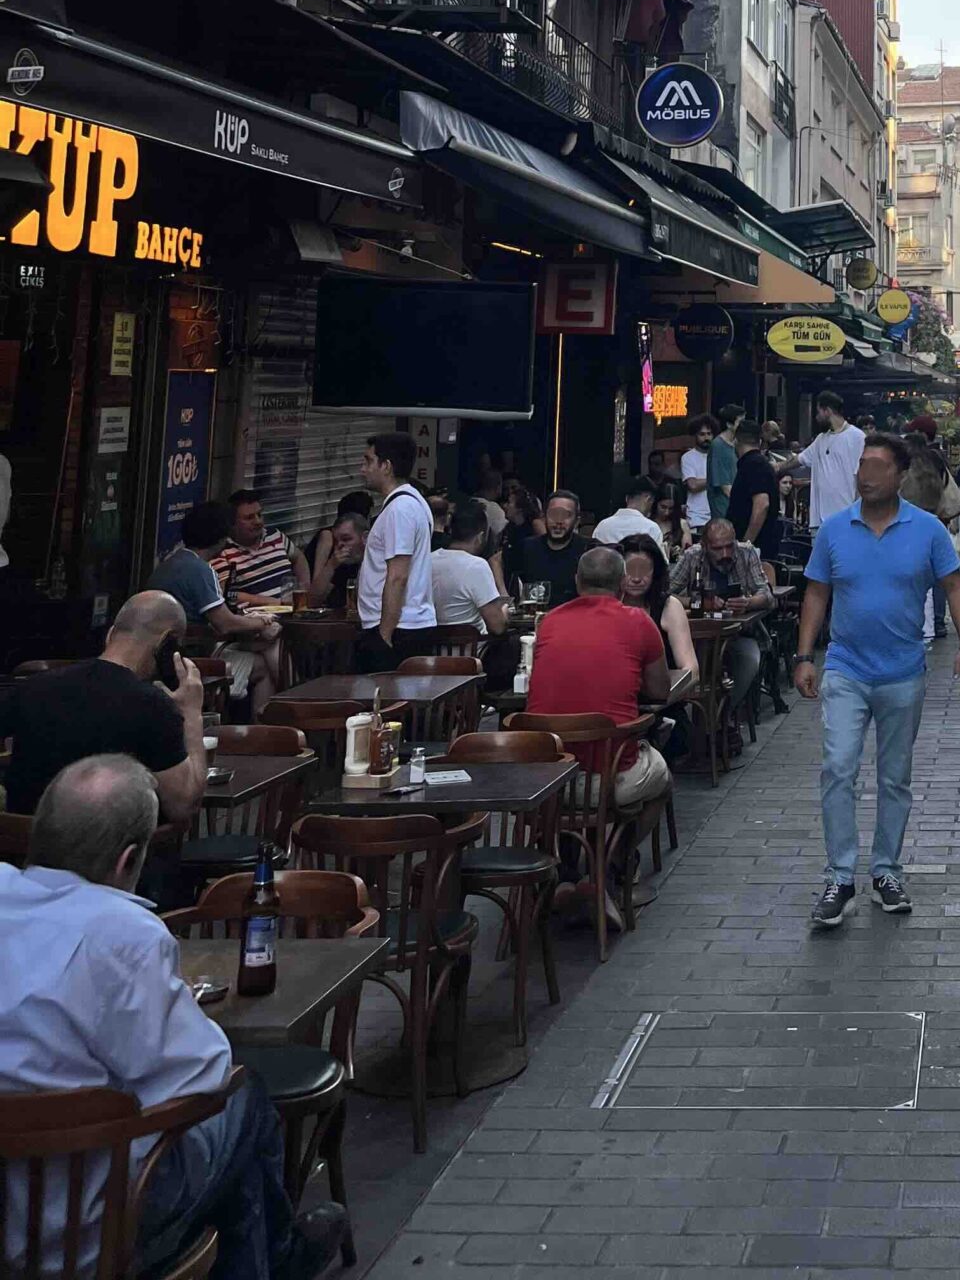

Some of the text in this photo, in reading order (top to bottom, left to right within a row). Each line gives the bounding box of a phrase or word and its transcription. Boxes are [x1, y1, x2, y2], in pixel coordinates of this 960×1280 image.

[646, 107, 711, 121] MÖBIUS
[214, 109, 250, 155] KÜP
[134, 221, 204, 271] BAHÇE
[20, 266, 45, 277] EXIT
[556, 274, 596, 326] E
[783, 321, 830, 330] KARŞI SAHNE
[791, 329, 832, 341] TÜM GÜN
